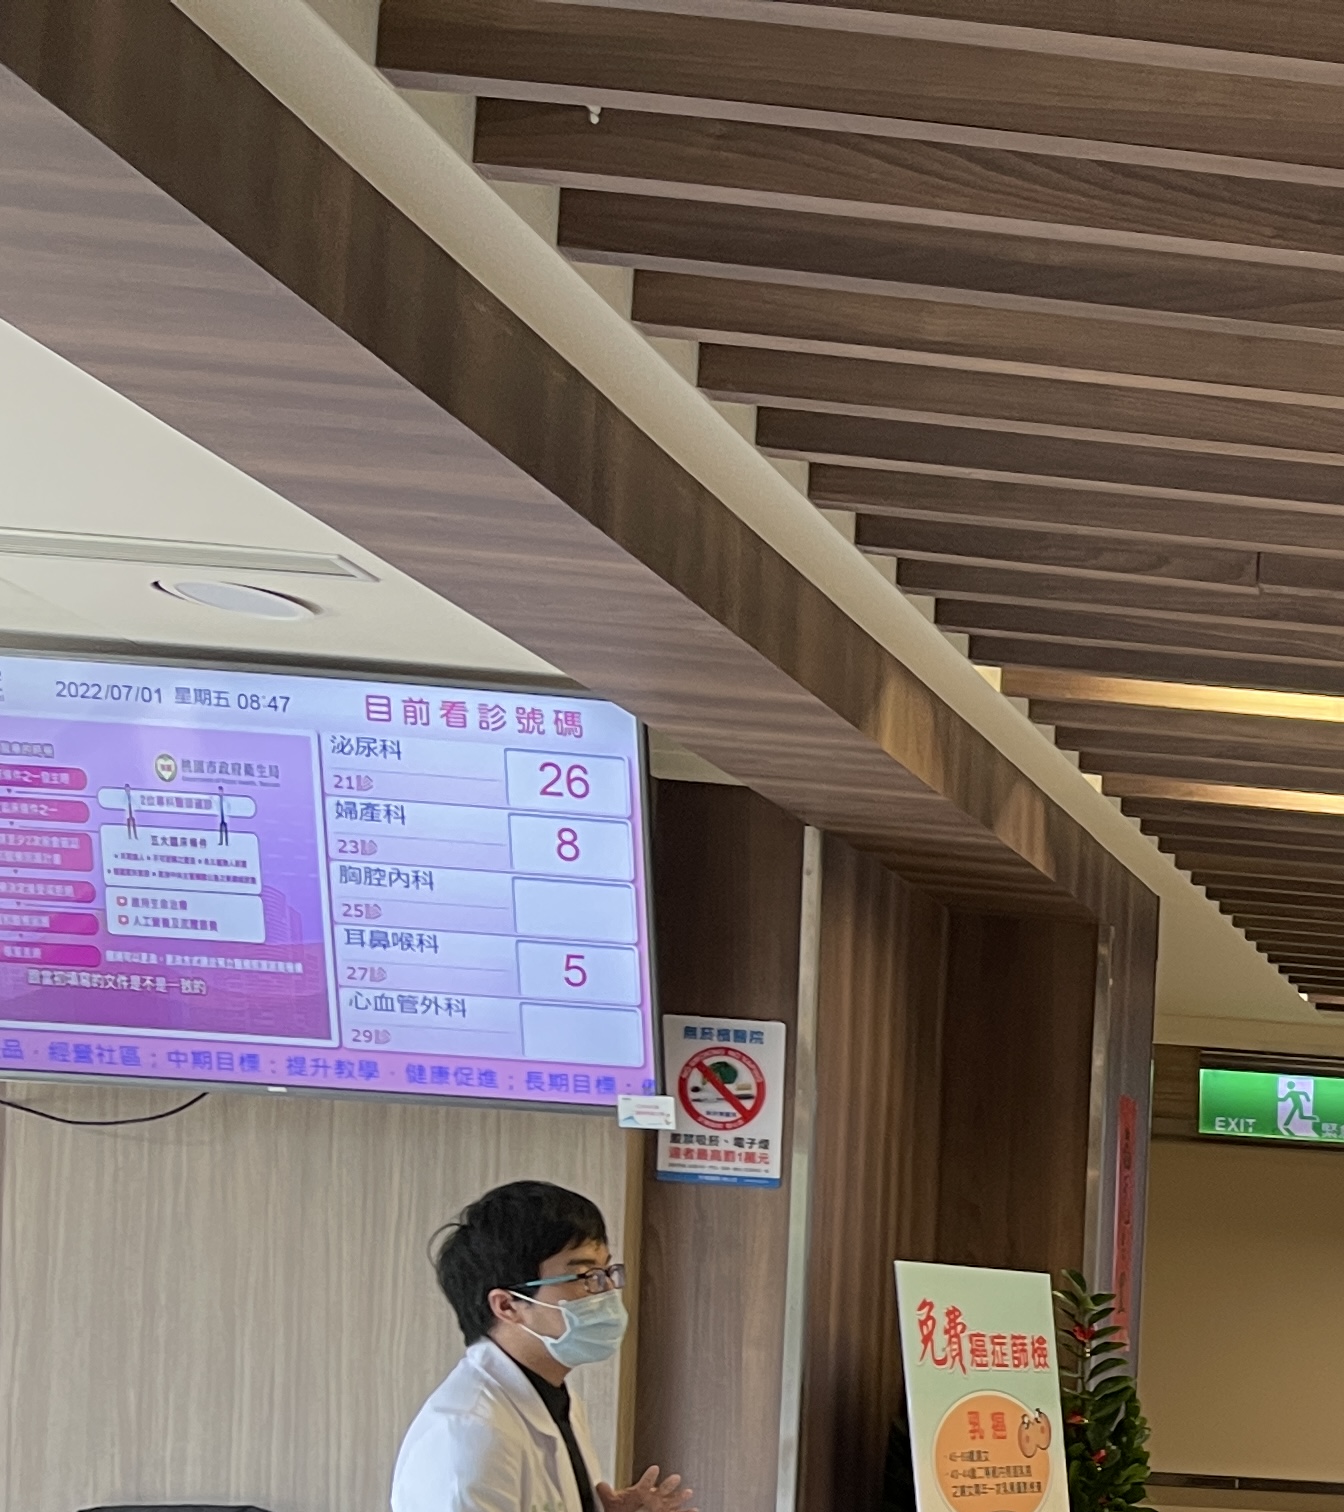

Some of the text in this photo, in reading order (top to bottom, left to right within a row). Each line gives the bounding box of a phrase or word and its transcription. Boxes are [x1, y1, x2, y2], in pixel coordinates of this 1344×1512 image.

[55, 681, 290, 712] 2022/07/01 星期五 08:47
[365, 694, 584, 738] 目前看診號碼
[330, 735, 401, 760] 泌尿科
[538, 761, 590, 799] 26
[335, 800, 405, 825] 婦產科
[556, 827, 580, 861] 8
[339, 865, 434, 891] 胸腔內科
[344, 928, 439, 954] 耳鼻喉科
[563, 954, 587, 987] 5
[349, 992, 466, 1018] 心血管外科
[1215, 1117, 1256, 1132] EXIT
